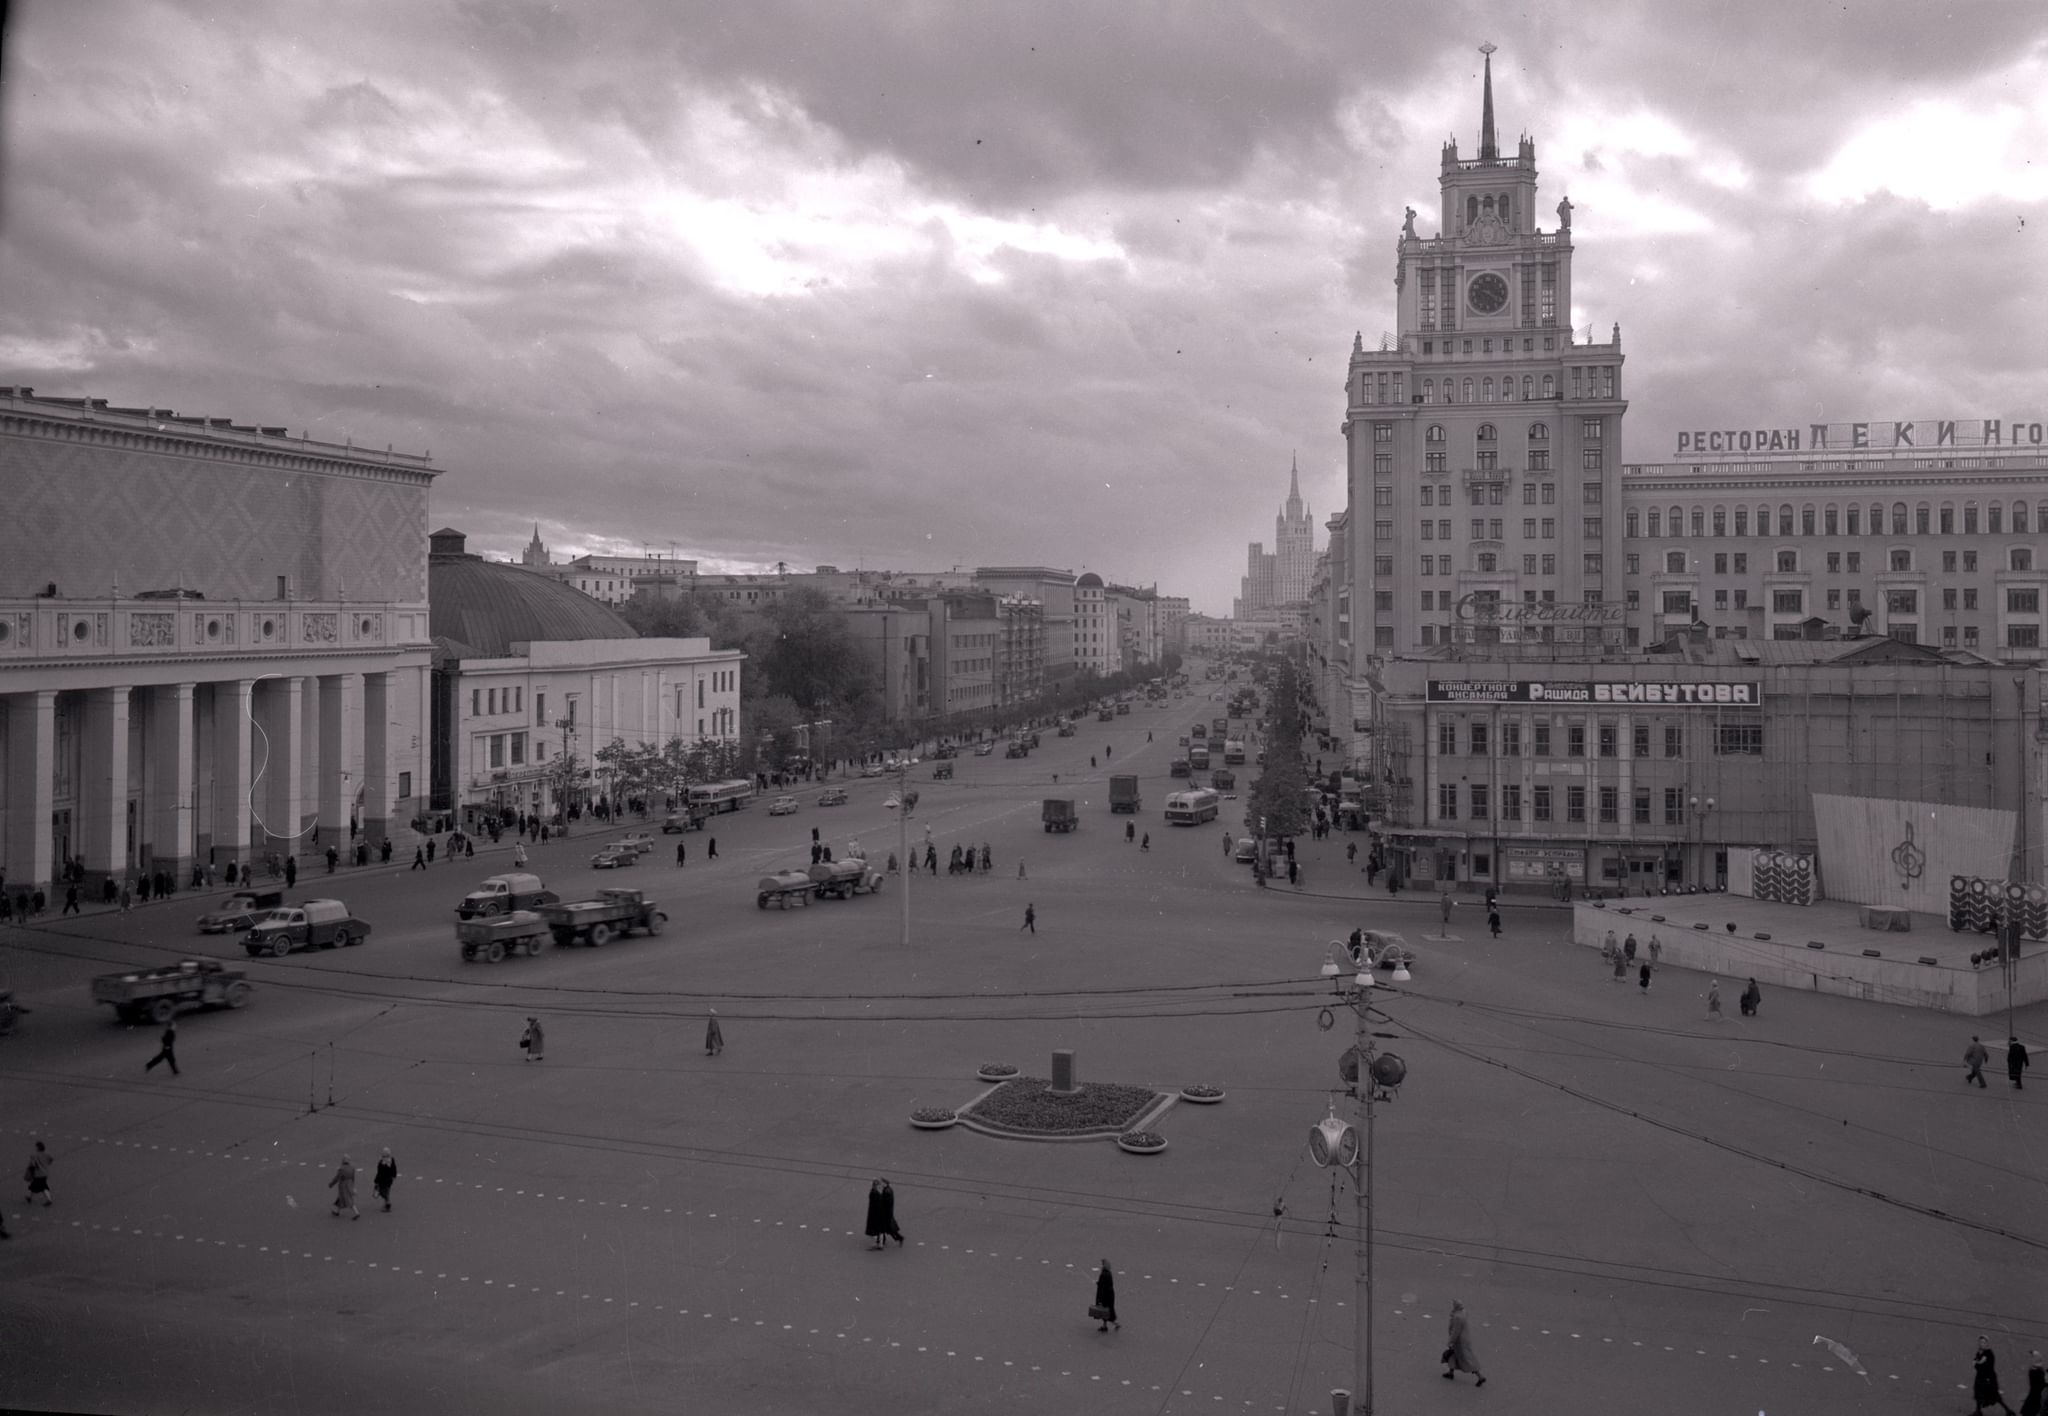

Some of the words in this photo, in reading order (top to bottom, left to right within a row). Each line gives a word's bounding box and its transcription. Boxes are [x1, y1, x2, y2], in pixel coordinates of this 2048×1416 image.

[1678, 429, 1800, 452] РЕСТОРАН
[1809, 419, 2001, 449] ПЕКИН
[2012, 422, 2048, 445] ГО
[1438, 682, 1518, 692] КОНЦЕРТНОГО
[1594, 682, 1750, 702] БЕЙБУТОВА
[1447, 690, 1508, 700] АНСАМБЛЯ
